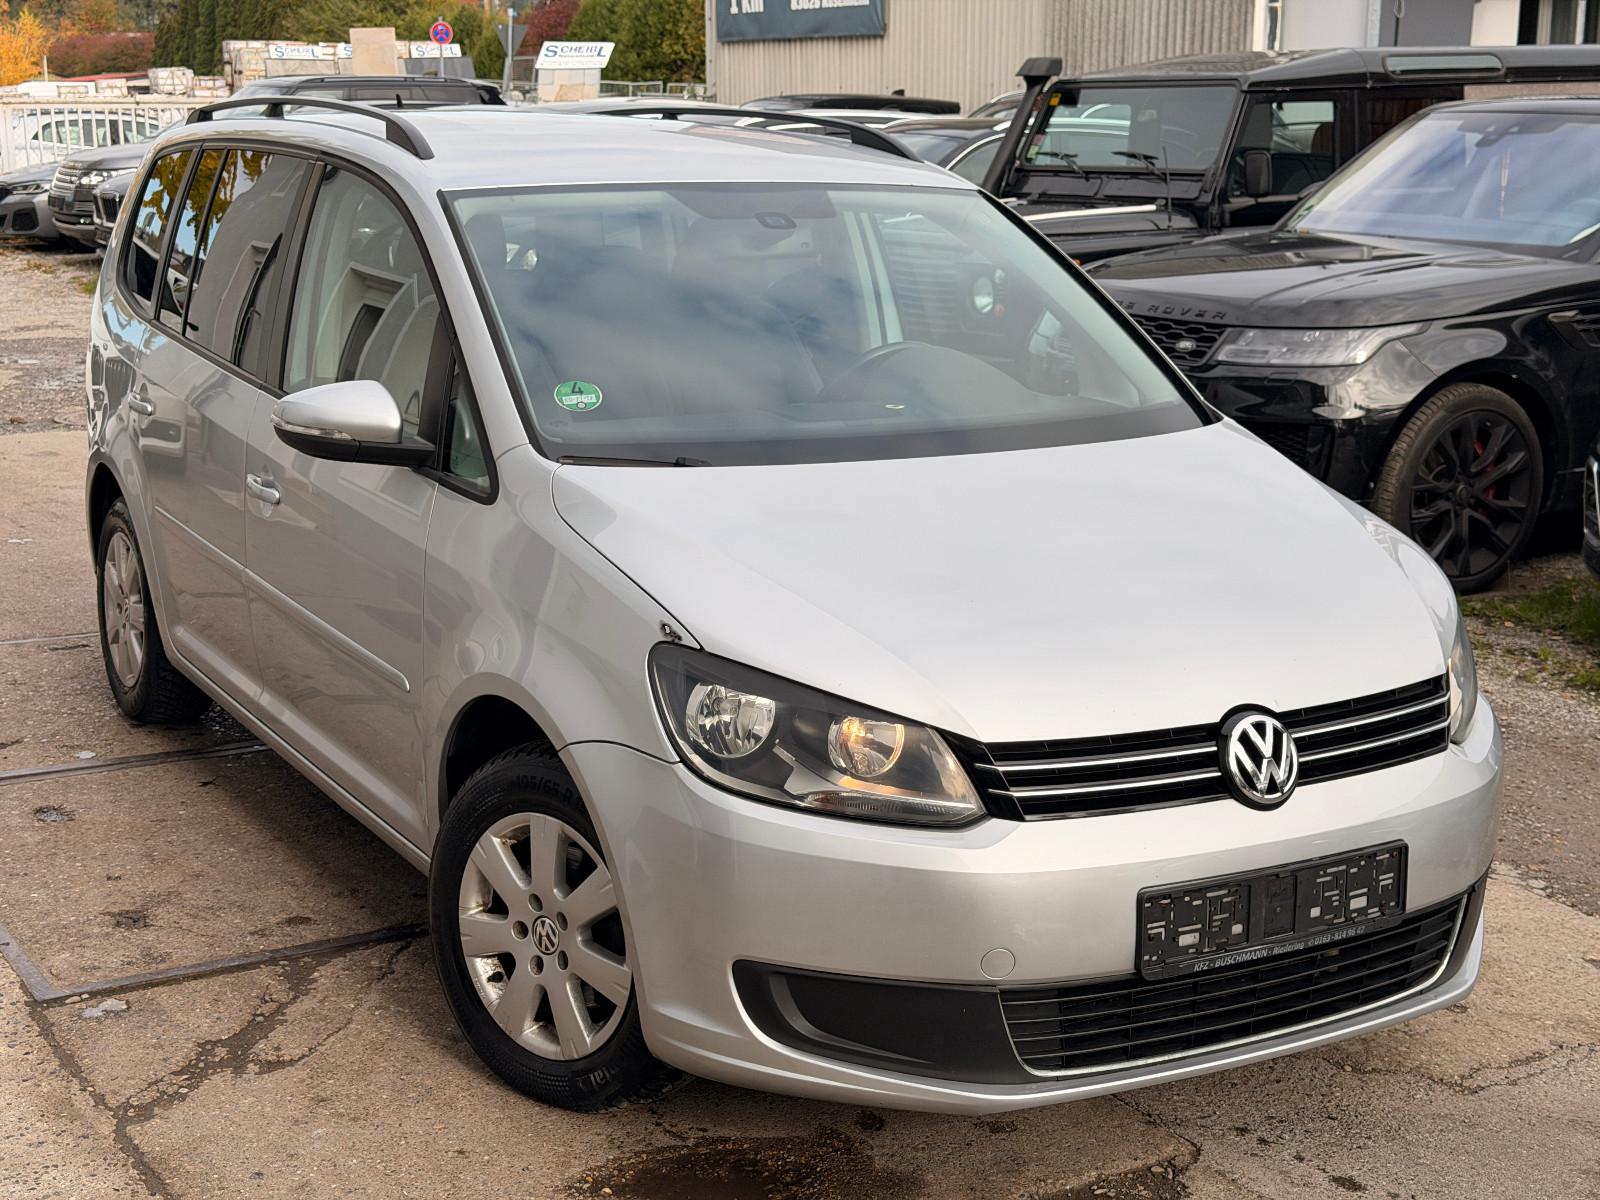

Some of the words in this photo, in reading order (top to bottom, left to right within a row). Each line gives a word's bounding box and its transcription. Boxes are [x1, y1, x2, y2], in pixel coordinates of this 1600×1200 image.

[1146, 304, 1227, 320] ROVER
[571, 381, 585, 396] 4
[1229, 714, 1298, 800] VW
[1193, 961, 1210, 972] KFZ
[1215, 948, 1269, 968] BUSCHMANN
